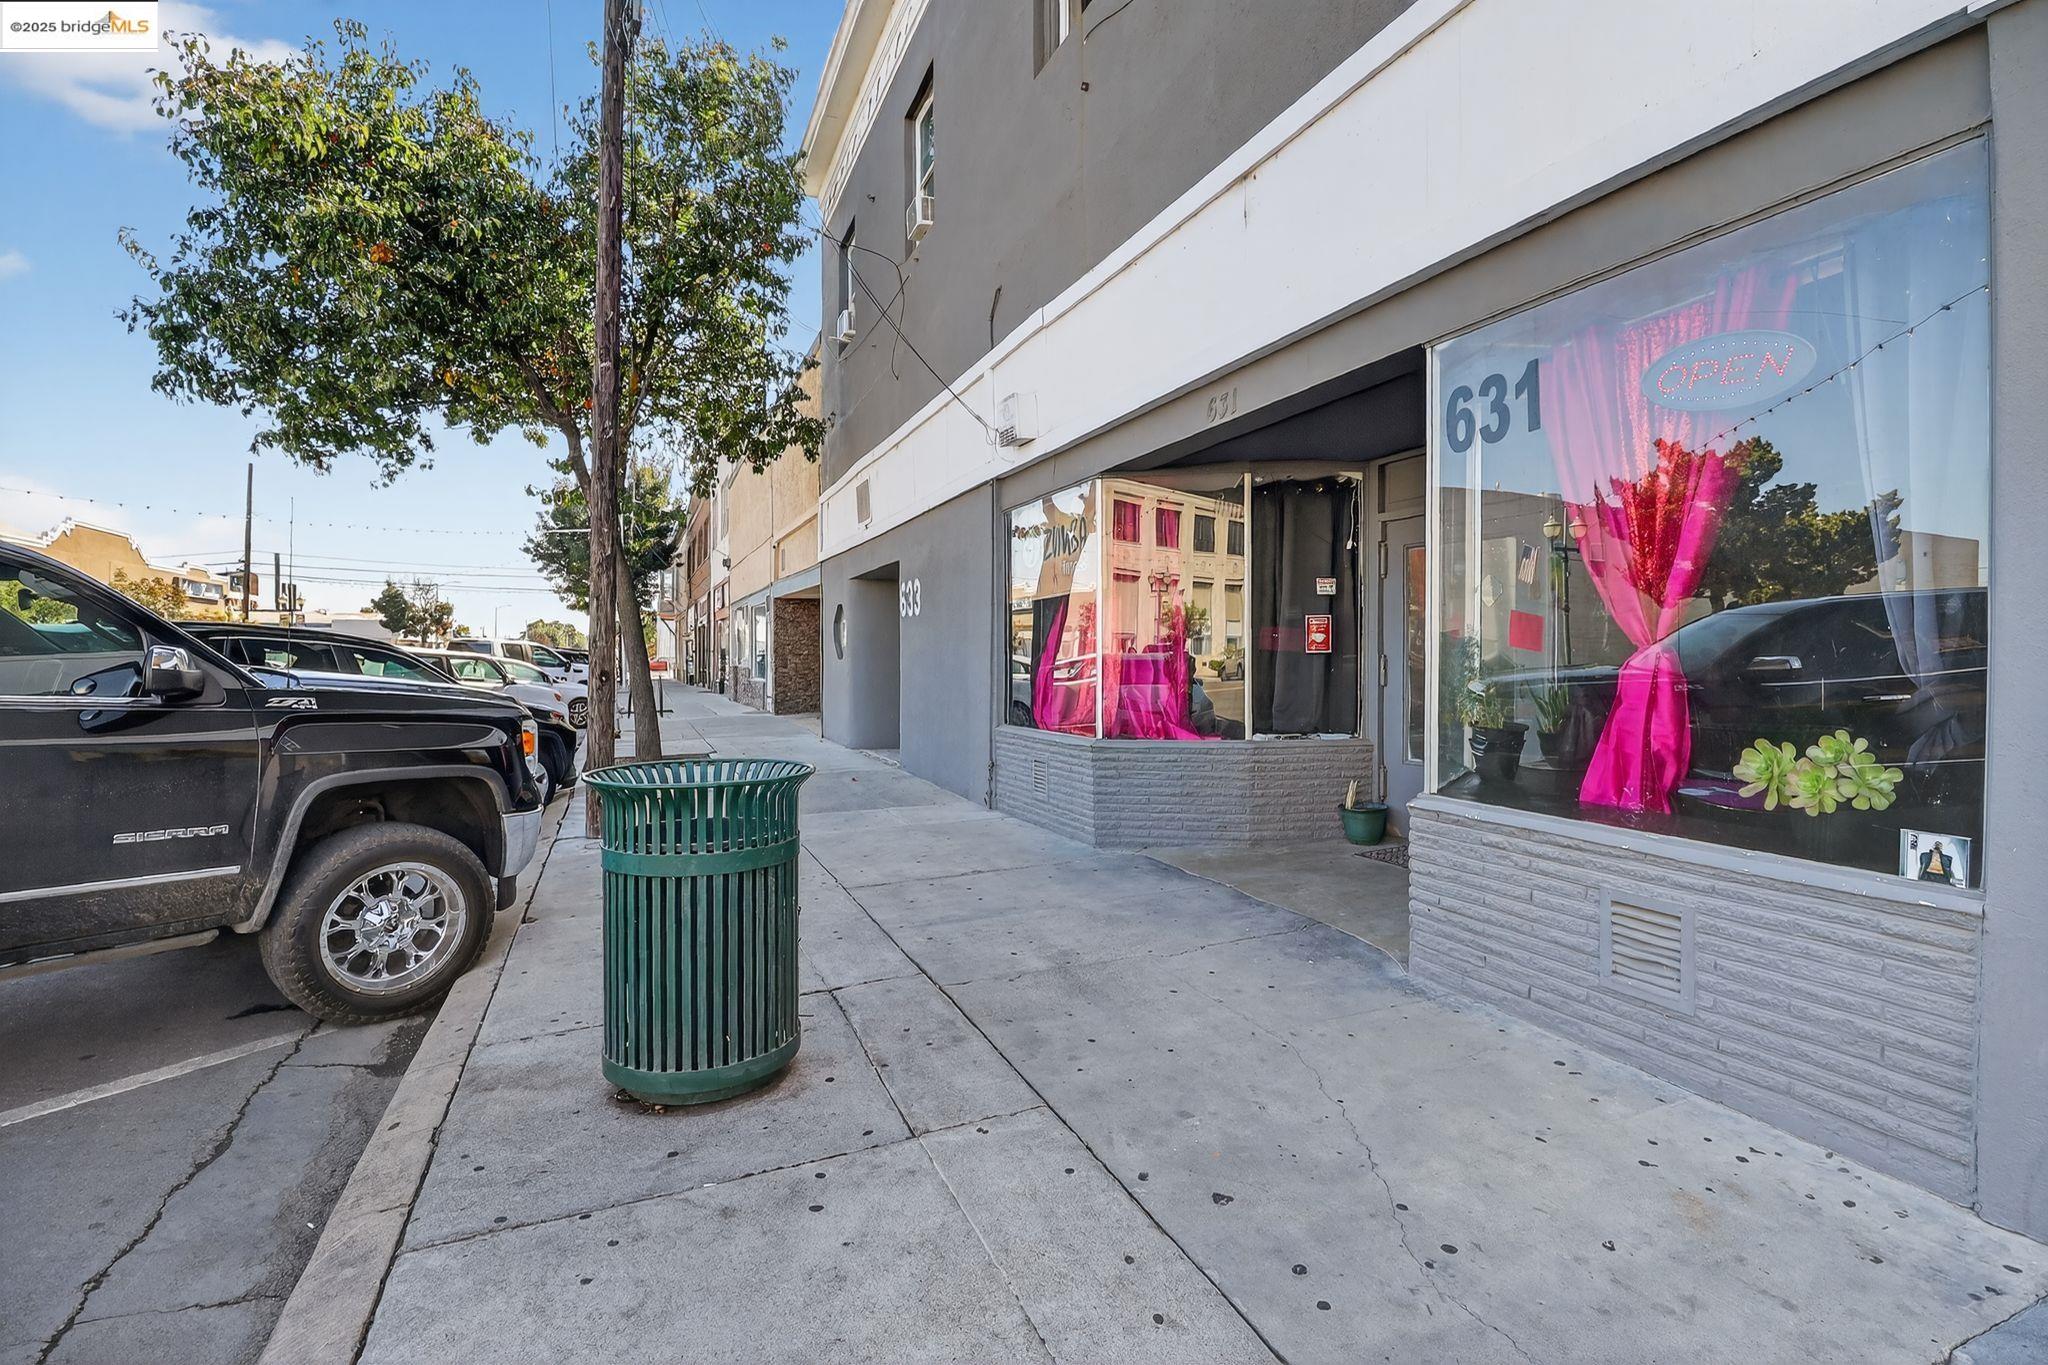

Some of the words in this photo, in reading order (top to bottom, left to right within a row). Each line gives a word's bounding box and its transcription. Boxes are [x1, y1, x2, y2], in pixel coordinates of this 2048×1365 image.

[1656, 346, 1795, 395] OPEN
[1207, 387, 1238, 424] 631
[1446, 358, 1542, 453] 631
[113, 824, 229, 844] SIERRA
